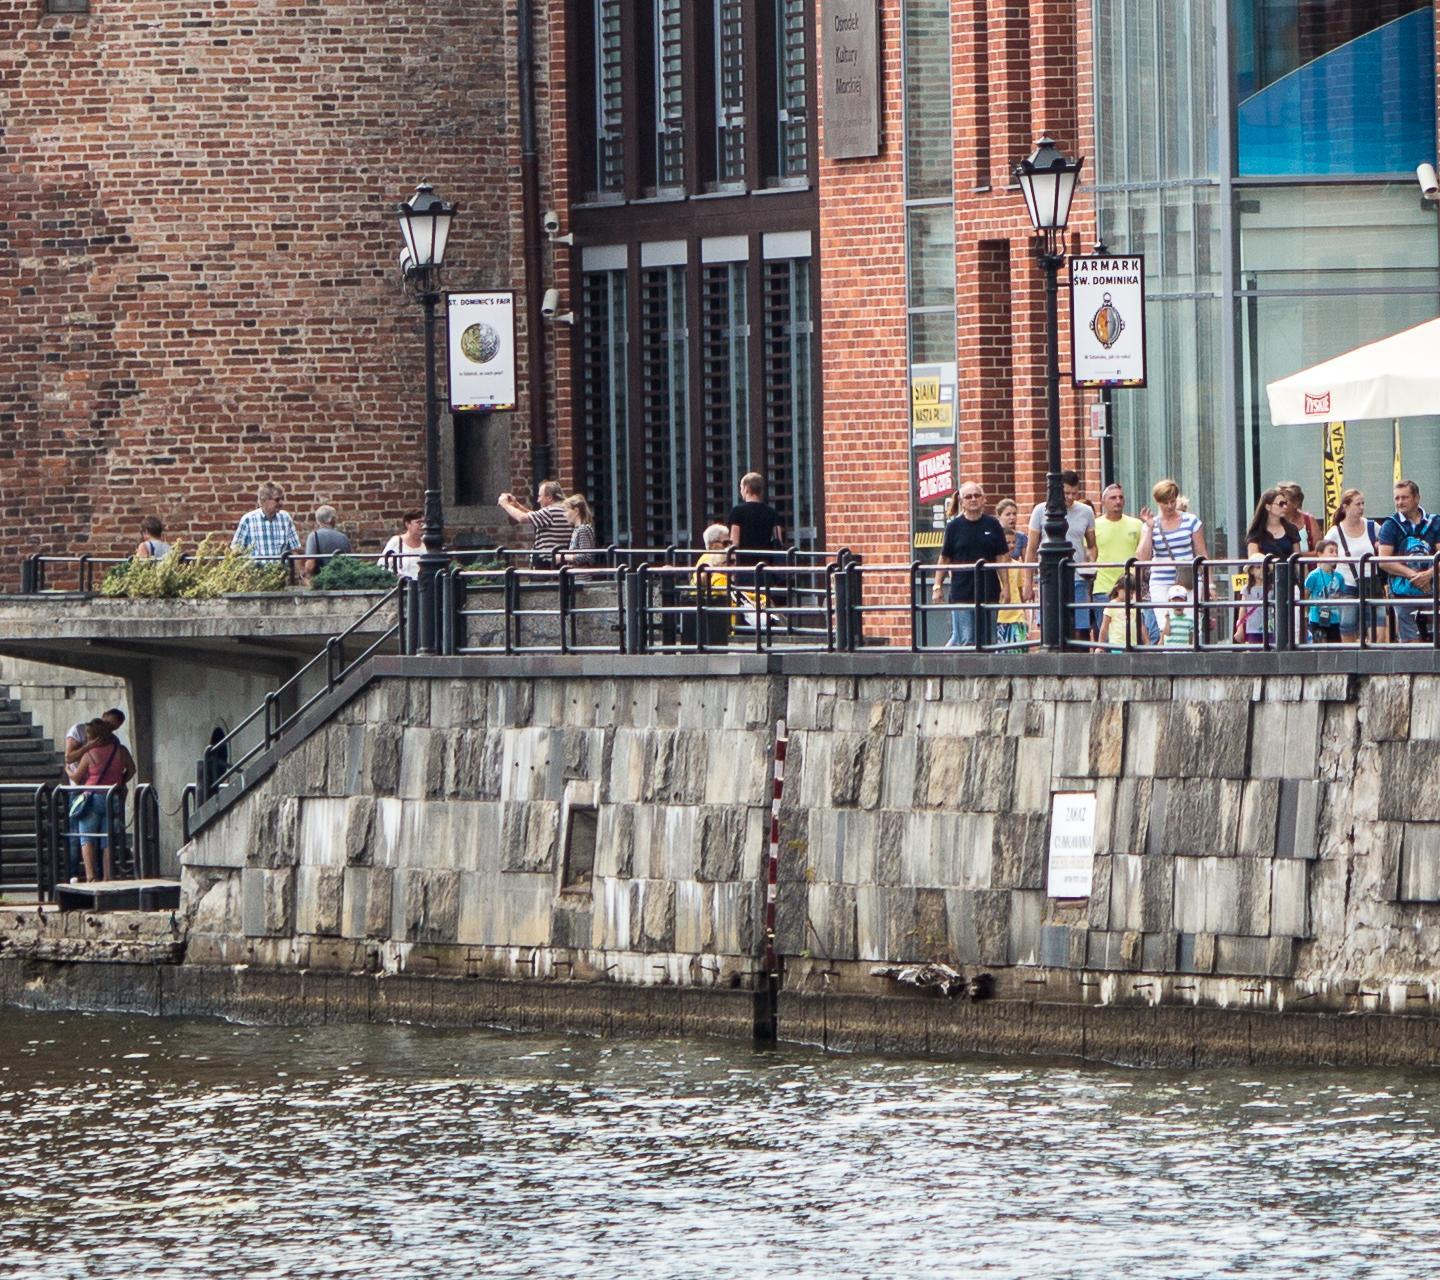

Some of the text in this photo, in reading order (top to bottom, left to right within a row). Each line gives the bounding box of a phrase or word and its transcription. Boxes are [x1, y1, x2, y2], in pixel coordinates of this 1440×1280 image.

[1073, 260, 1139, 272] JARMARK
[1073, 275, 1139, 286] ŚW. DOMINIKA
